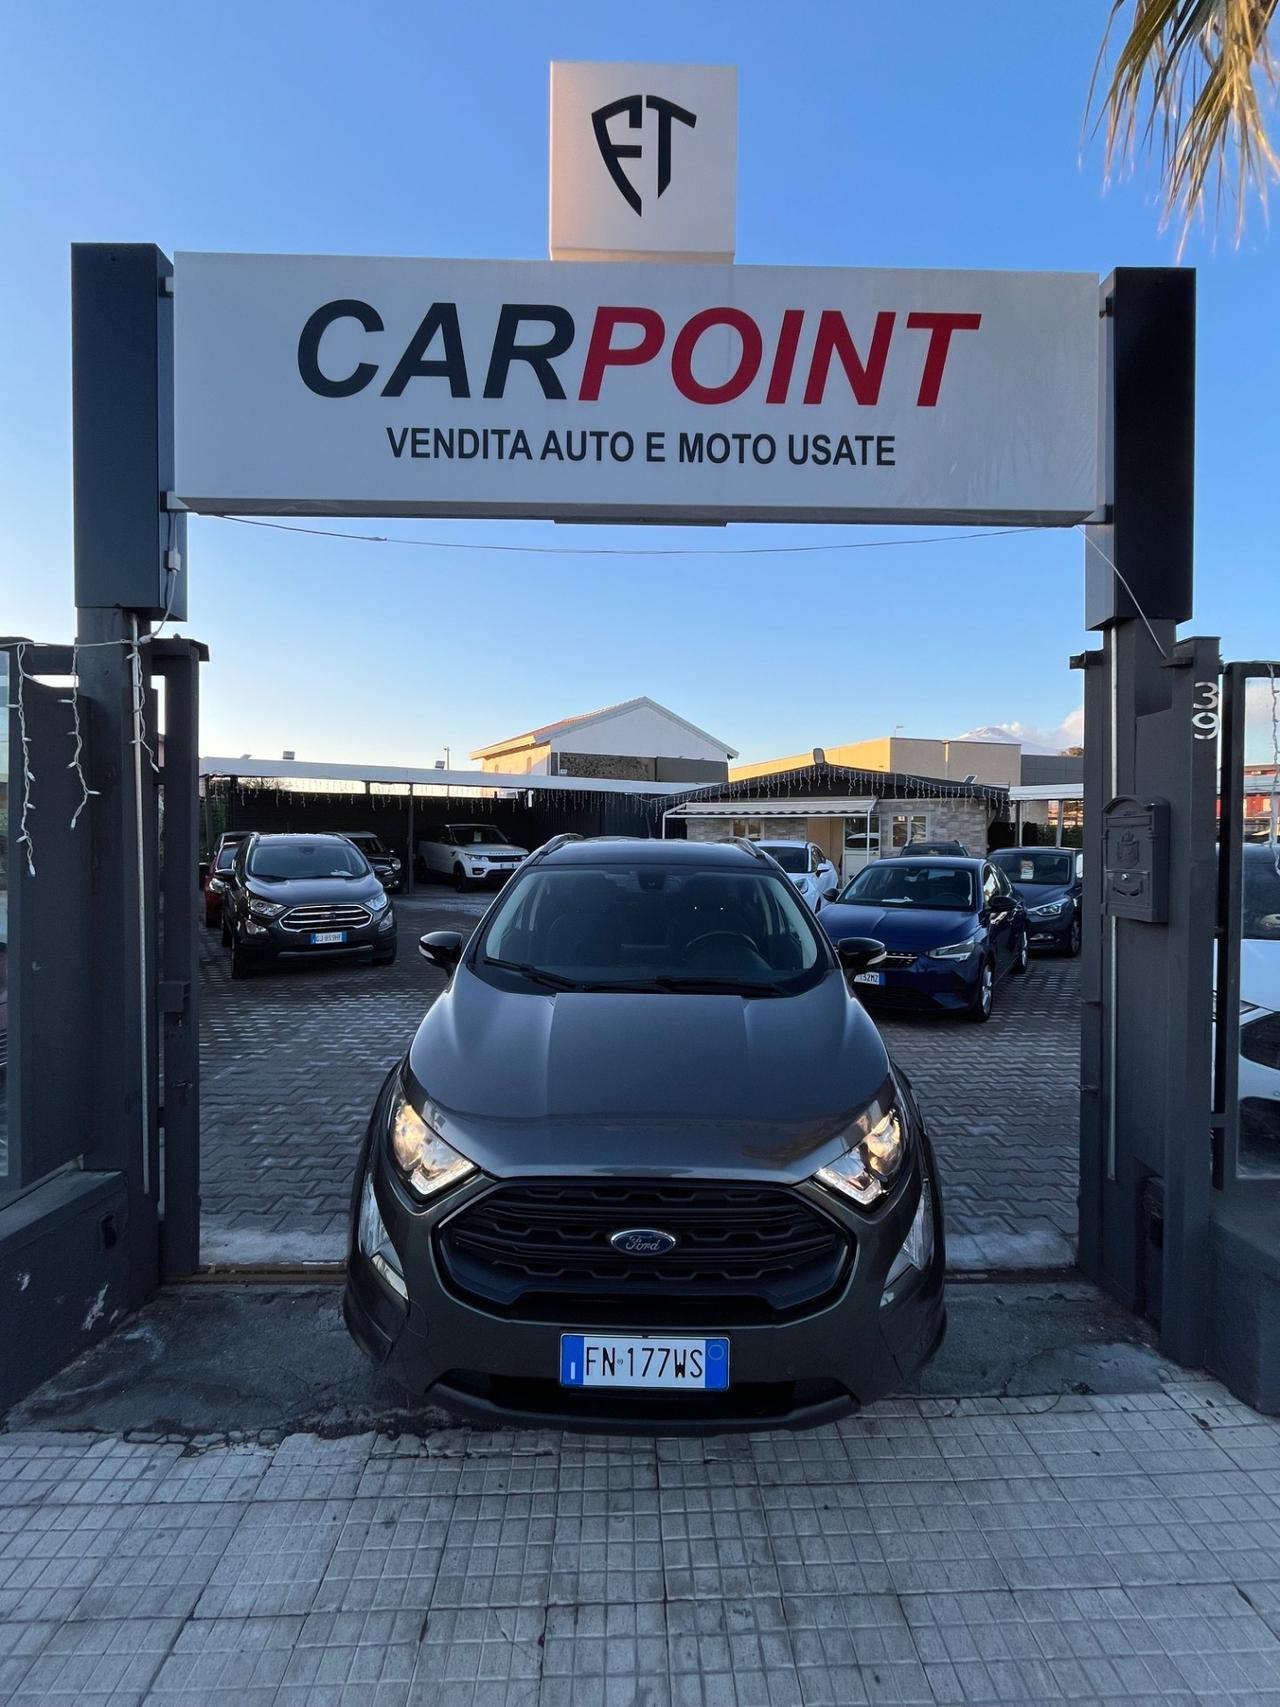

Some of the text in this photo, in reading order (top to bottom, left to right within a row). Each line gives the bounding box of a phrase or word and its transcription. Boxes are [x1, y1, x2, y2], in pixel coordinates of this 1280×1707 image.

[591, 94, 697, 218] FT
[297, 298, 981, 406] CARPOINT
[386, 427, 896, 466] VENDITA AUTO E MOTO USATE
[625, 1234, 661, 1251] Ford
